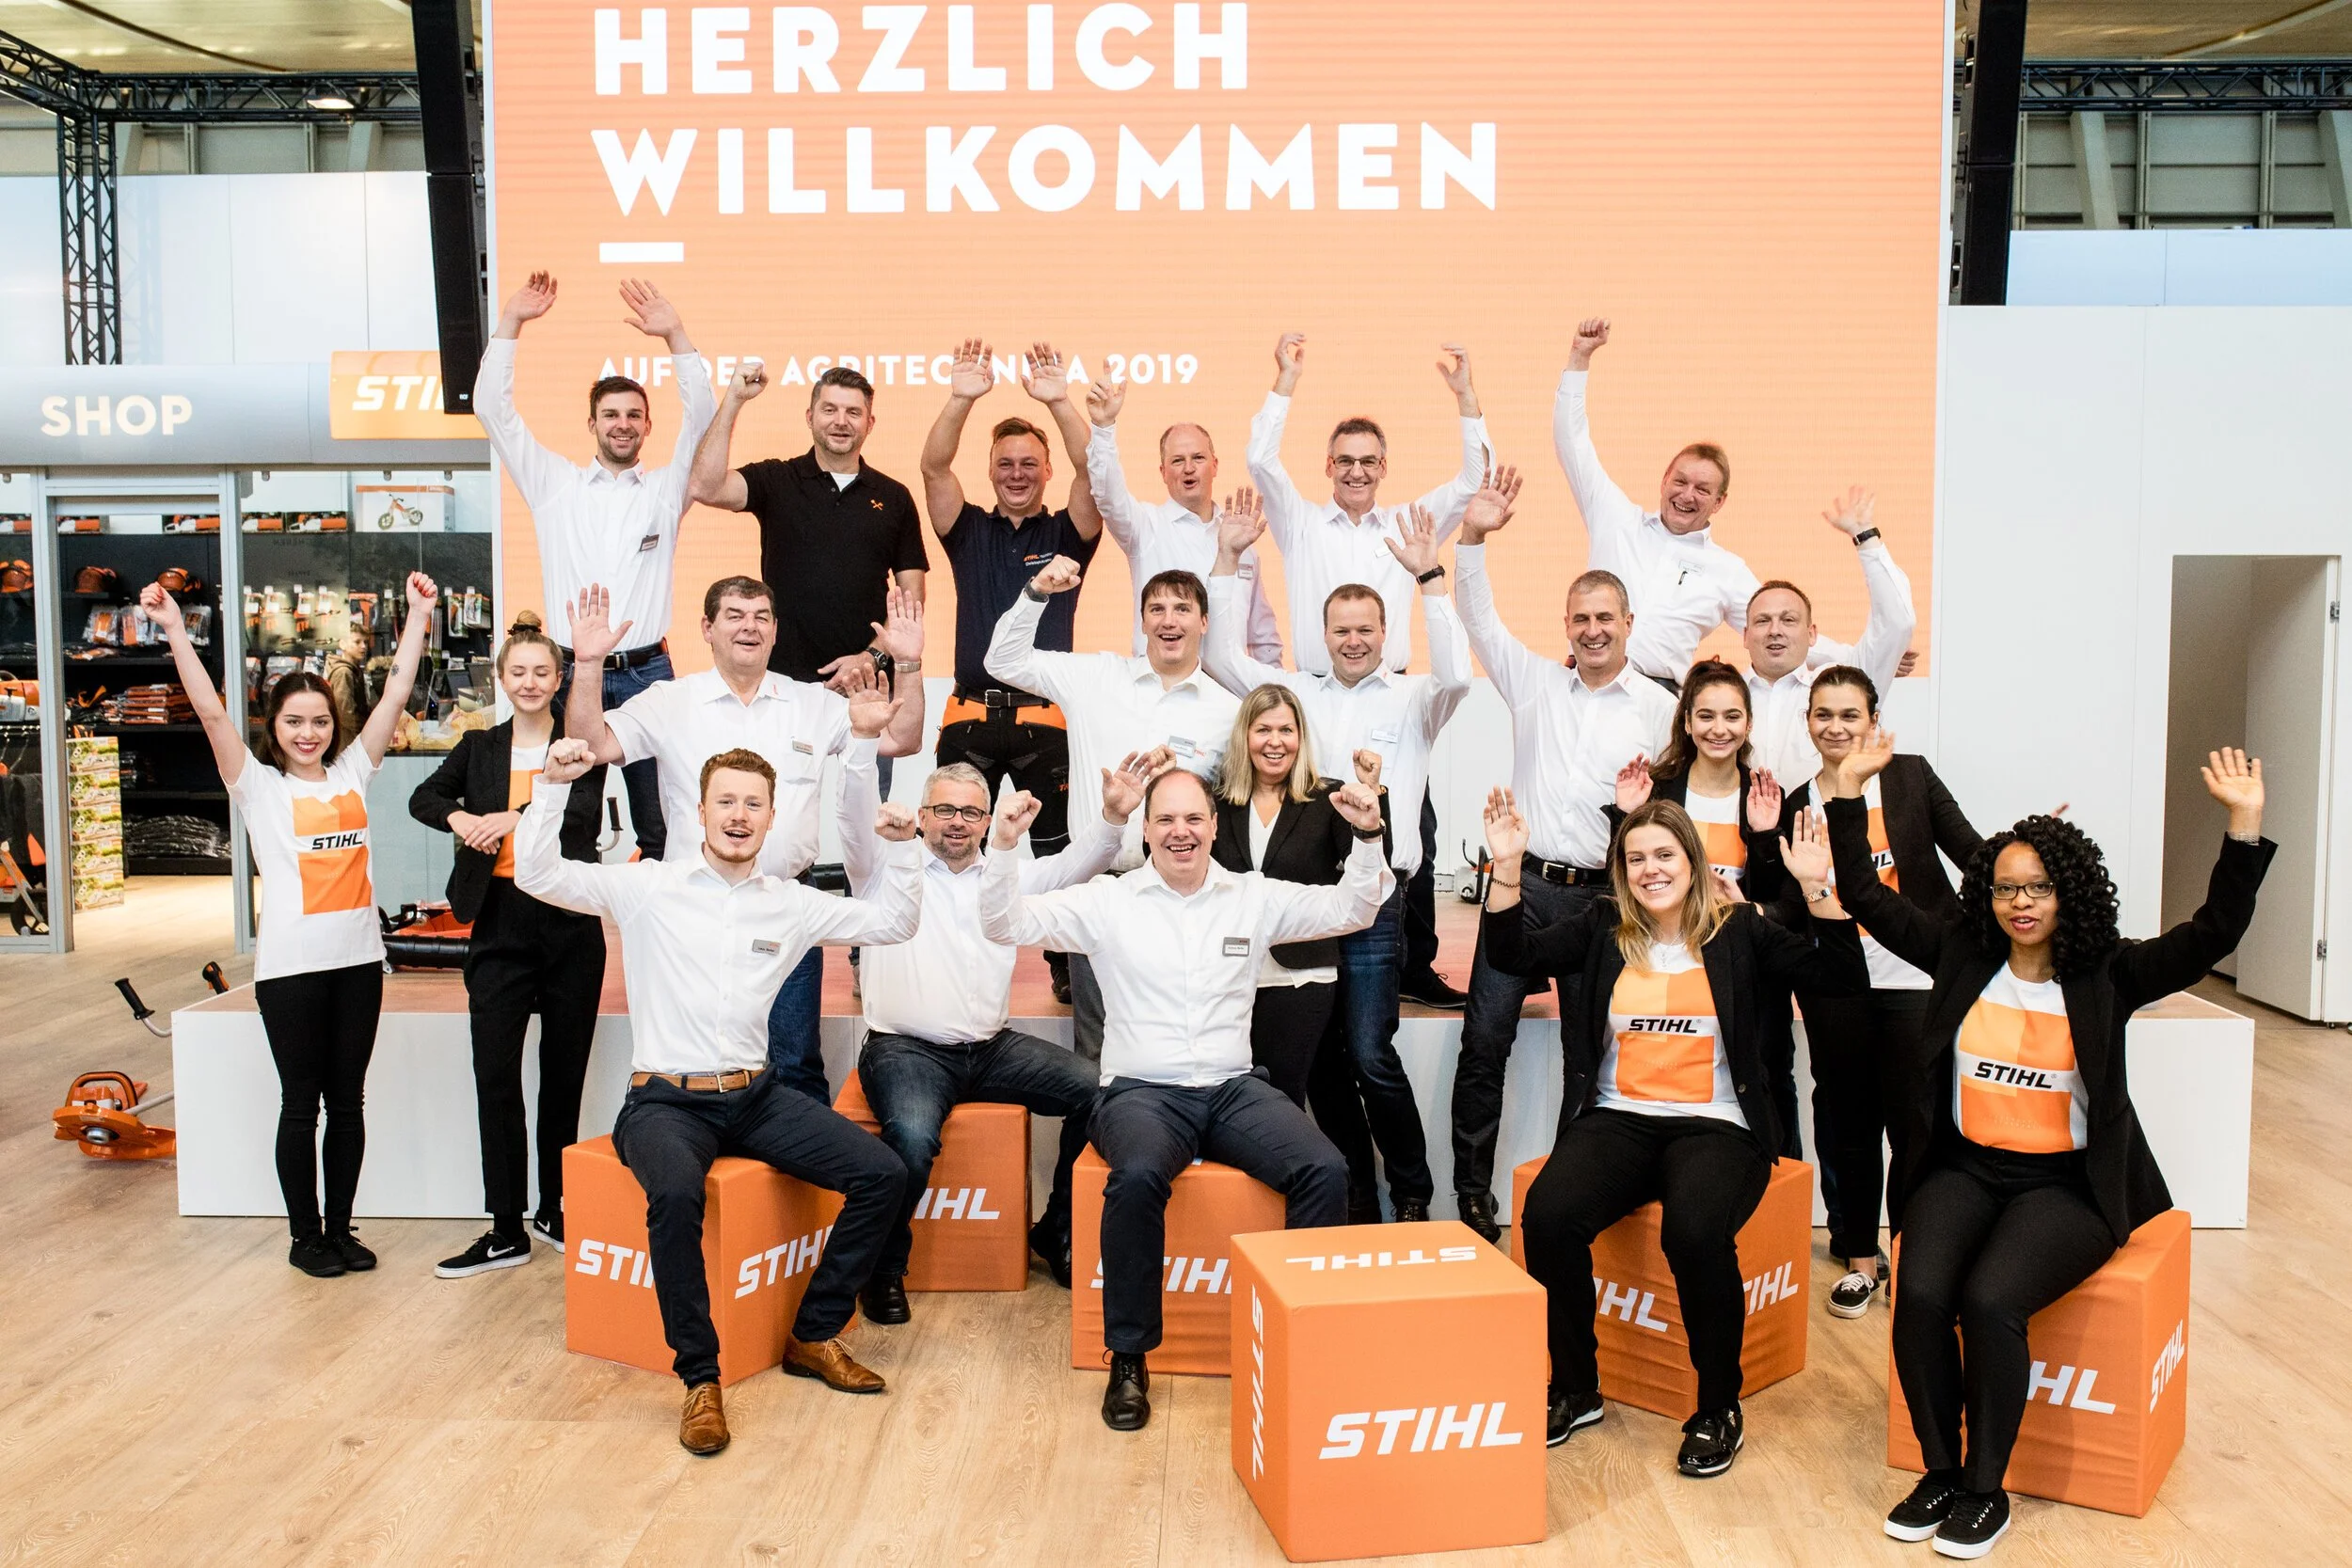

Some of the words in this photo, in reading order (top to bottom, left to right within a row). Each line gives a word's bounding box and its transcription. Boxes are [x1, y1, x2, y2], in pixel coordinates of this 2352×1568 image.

[595, 2, 1248, 95] HERZLICH
[590, 121, 1497, 216] WILLKOMMEN
[597, 356, 672, 387] AUF
[1105, 353, 1199, 385] 2019
[352, 375, 444, 411] STI
[40, 395, 193, 436] SHOP
[311, 832, 363, 850] STIHL
[1629, 1019, 1697, 1034] STIHL
[1974, 1061, 2053, 1088] STIHL
[914, 1188, 1000, 1220] IHL
[575, 1239, 654, 1289] STI
[1286, 1245, 1477, 1272] STIHL
[1743, 1260, 1799, 1317] IHL
[1251, 1283, 1264, 1482] STIHL
[2149, 1319, 2185, 1415] STIHL
[1318, 1402, 1523, 1460] STIHL
